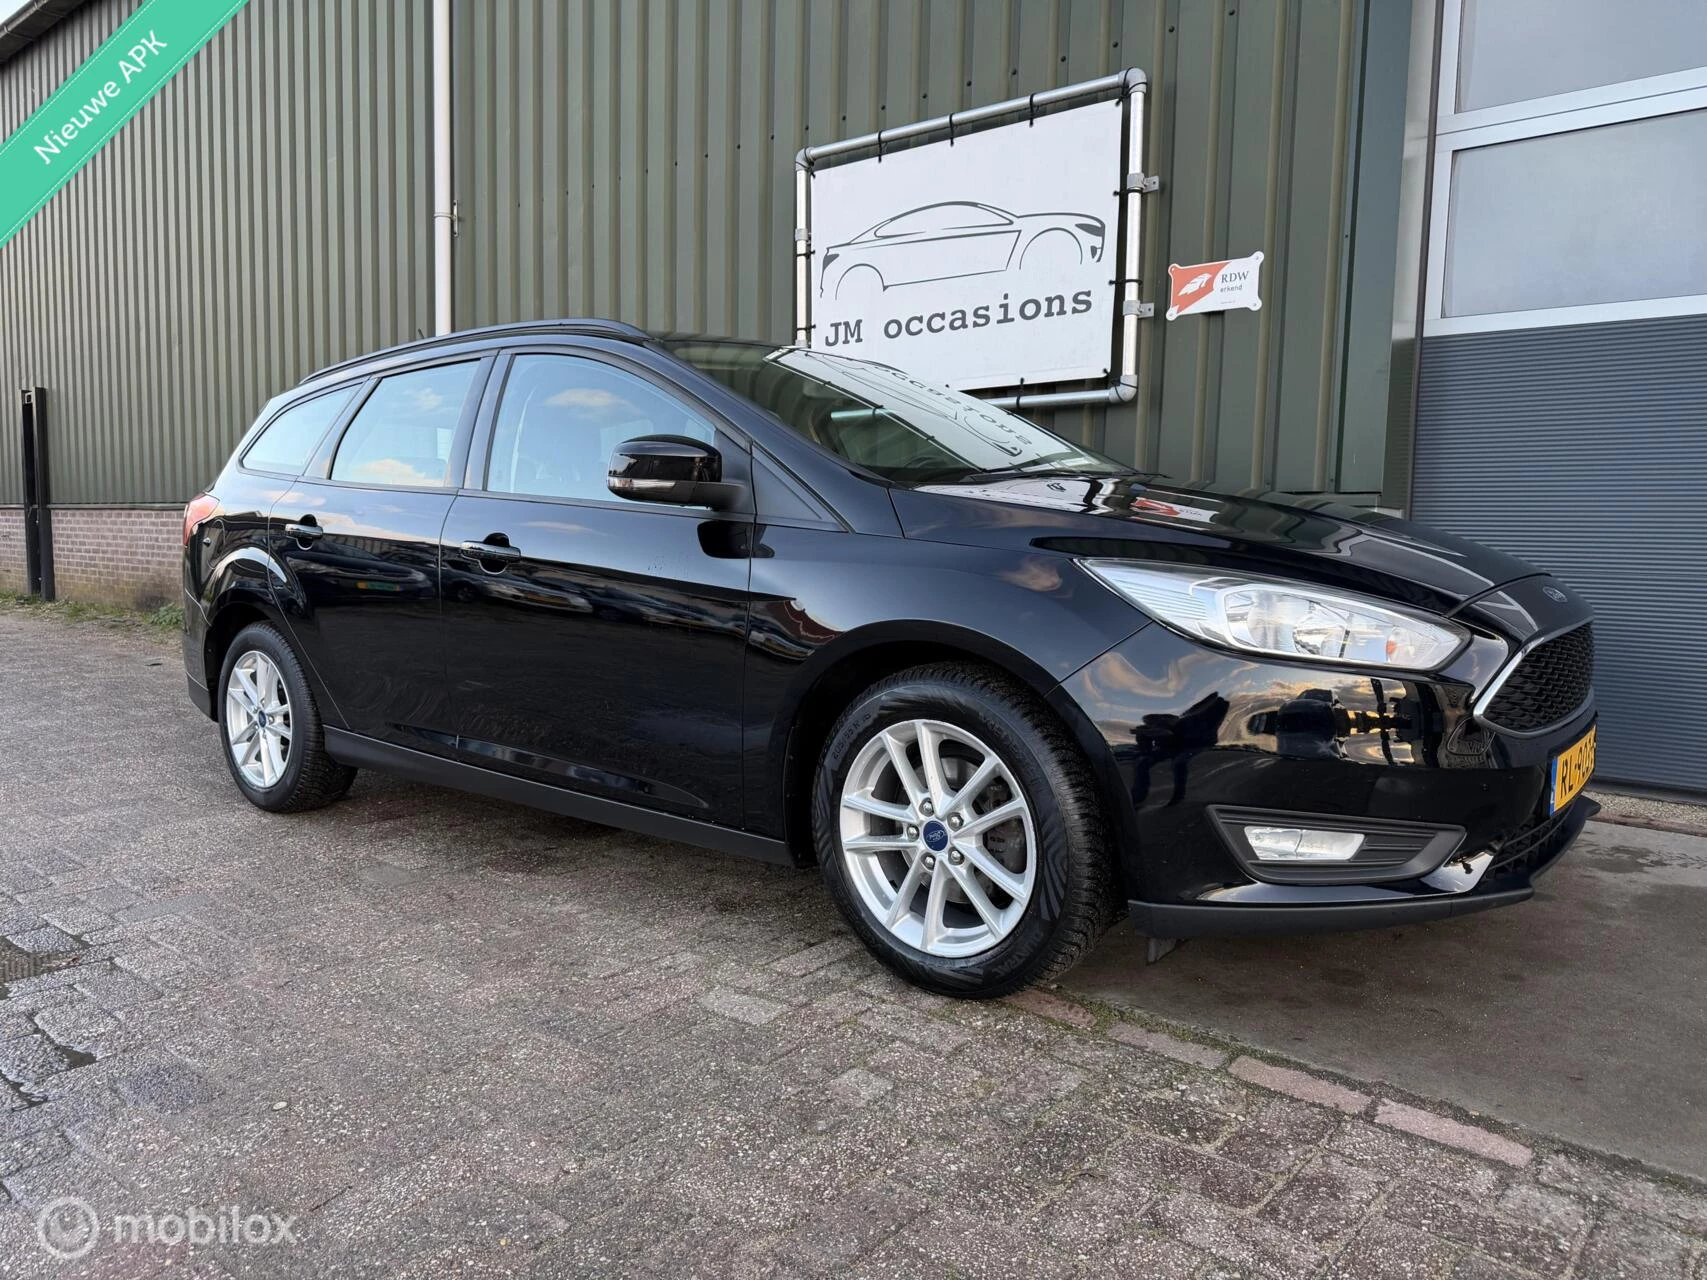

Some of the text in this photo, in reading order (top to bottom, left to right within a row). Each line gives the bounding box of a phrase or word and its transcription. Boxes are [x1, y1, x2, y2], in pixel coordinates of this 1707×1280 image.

[1221, 270, 1249, 284] RDW
[1220, 285, 1243, 293] erkend
[824, 289, 1093, 347] JM occasions
